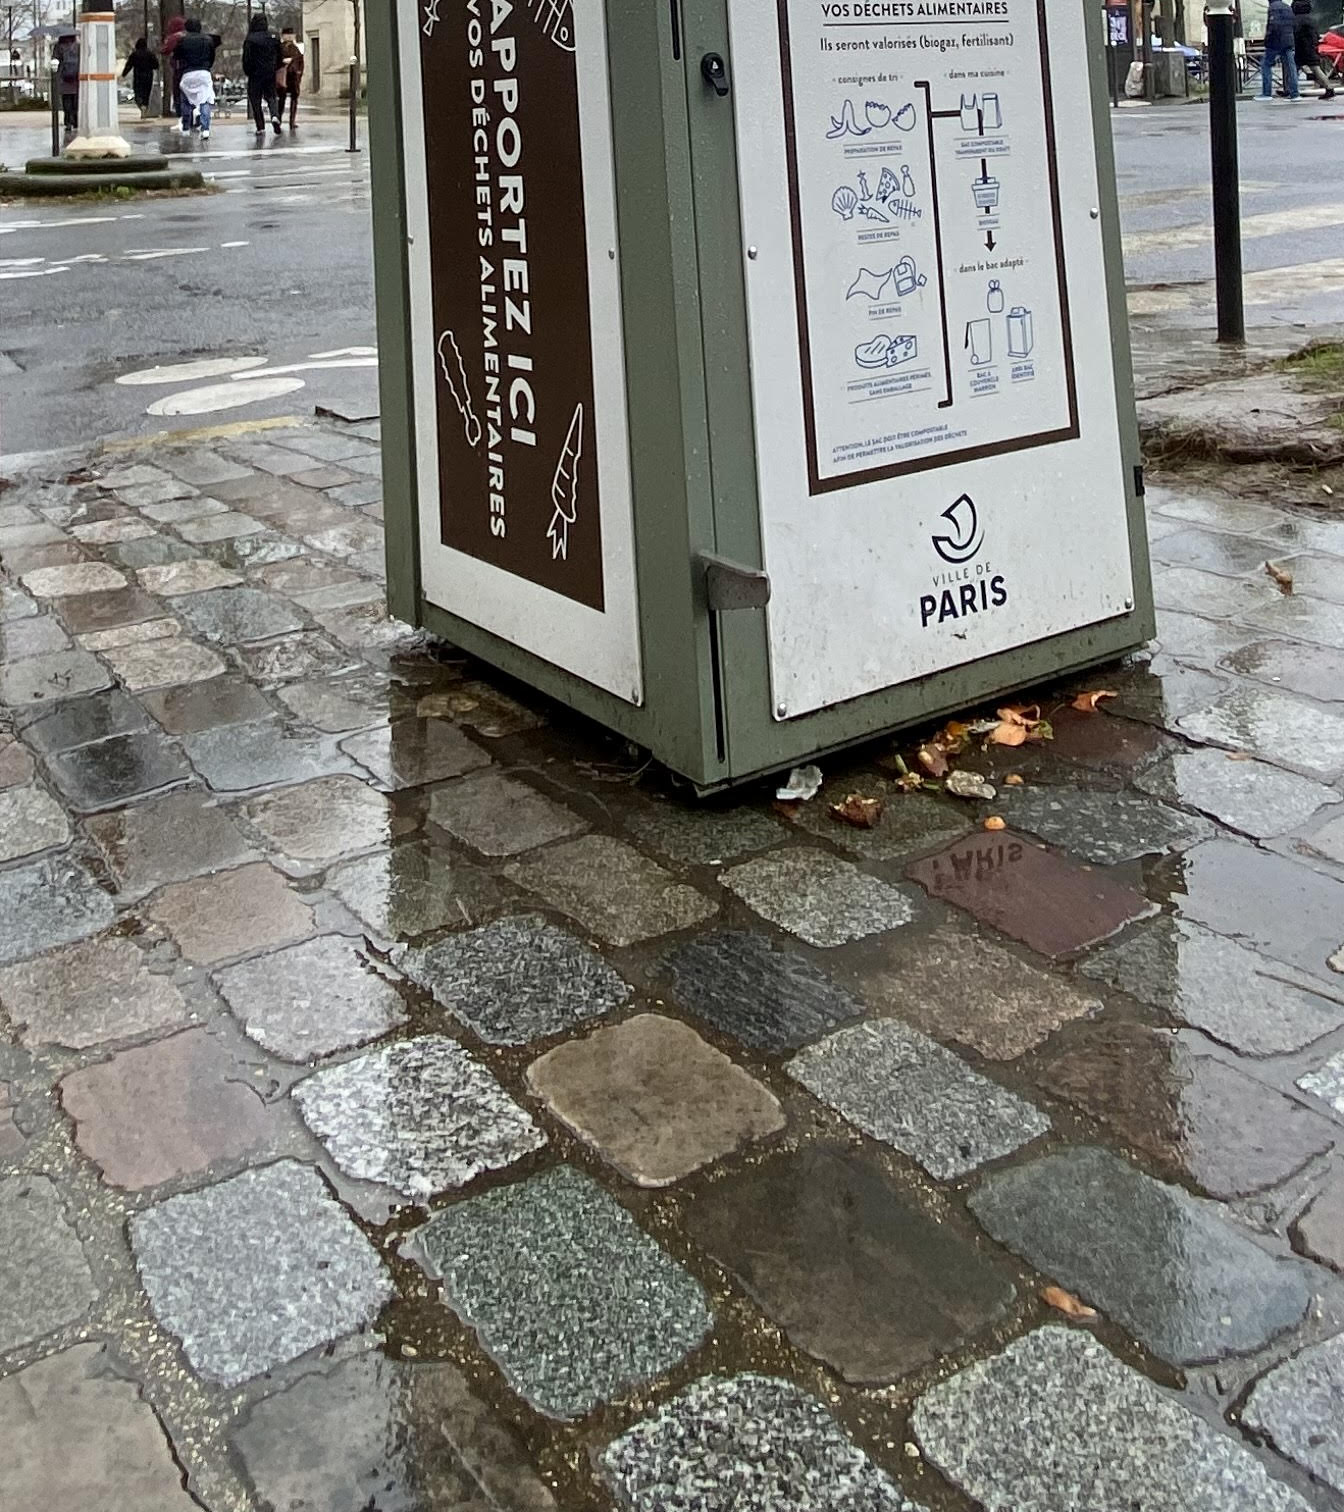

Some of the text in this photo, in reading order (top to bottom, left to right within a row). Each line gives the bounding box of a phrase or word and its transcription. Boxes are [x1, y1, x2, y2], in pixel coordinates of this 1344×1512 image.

[821, 0, 1008, 17] VOS DÉCHETS ALIMENTAIRES
[820, 38, 833, 51] Ils
[836, 39, 870, 51] seront
[872, 36, 917, 50] valorisés
[962, 33, 1014, 48] fertilisant)
[838, 74, 876, 87] consignes
[470, 79, 493, 247] DÉCHETS
[959, 263, 976, 273] dans
[977, 261, 984, 271] le
[986, 260, 998, 270] bac
[479, 255, 505, 538] ALIMENTAIRES
[507, 354, 537, 446] ICI
[932, 561, 992, 587] VILLE DE
[920, 575, 1008, 628] PARIS
